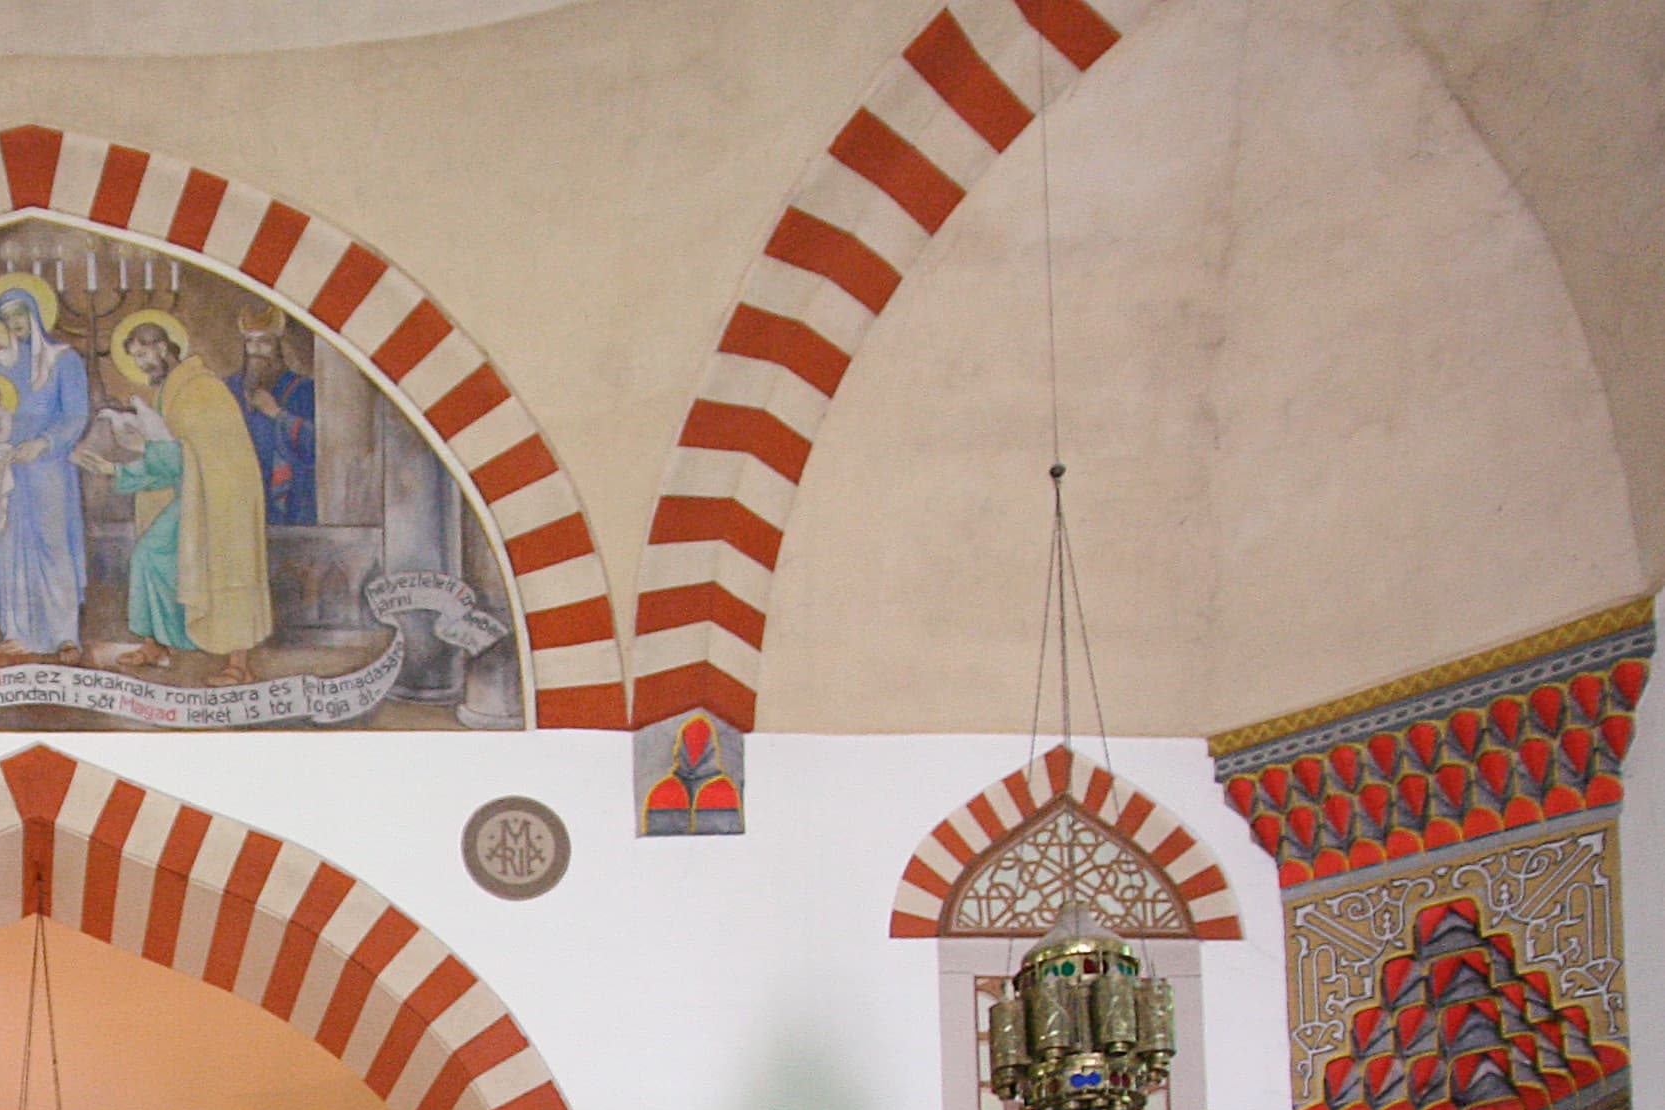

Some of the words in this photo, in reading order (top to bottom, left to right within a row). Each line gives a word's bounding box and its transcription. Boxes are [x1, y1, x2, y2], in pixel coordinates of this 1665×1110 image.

[35, 671, 62, 684] ez
[72, 672, 155, 699] sokaknak
[119, 695, 175, 721] Magad
